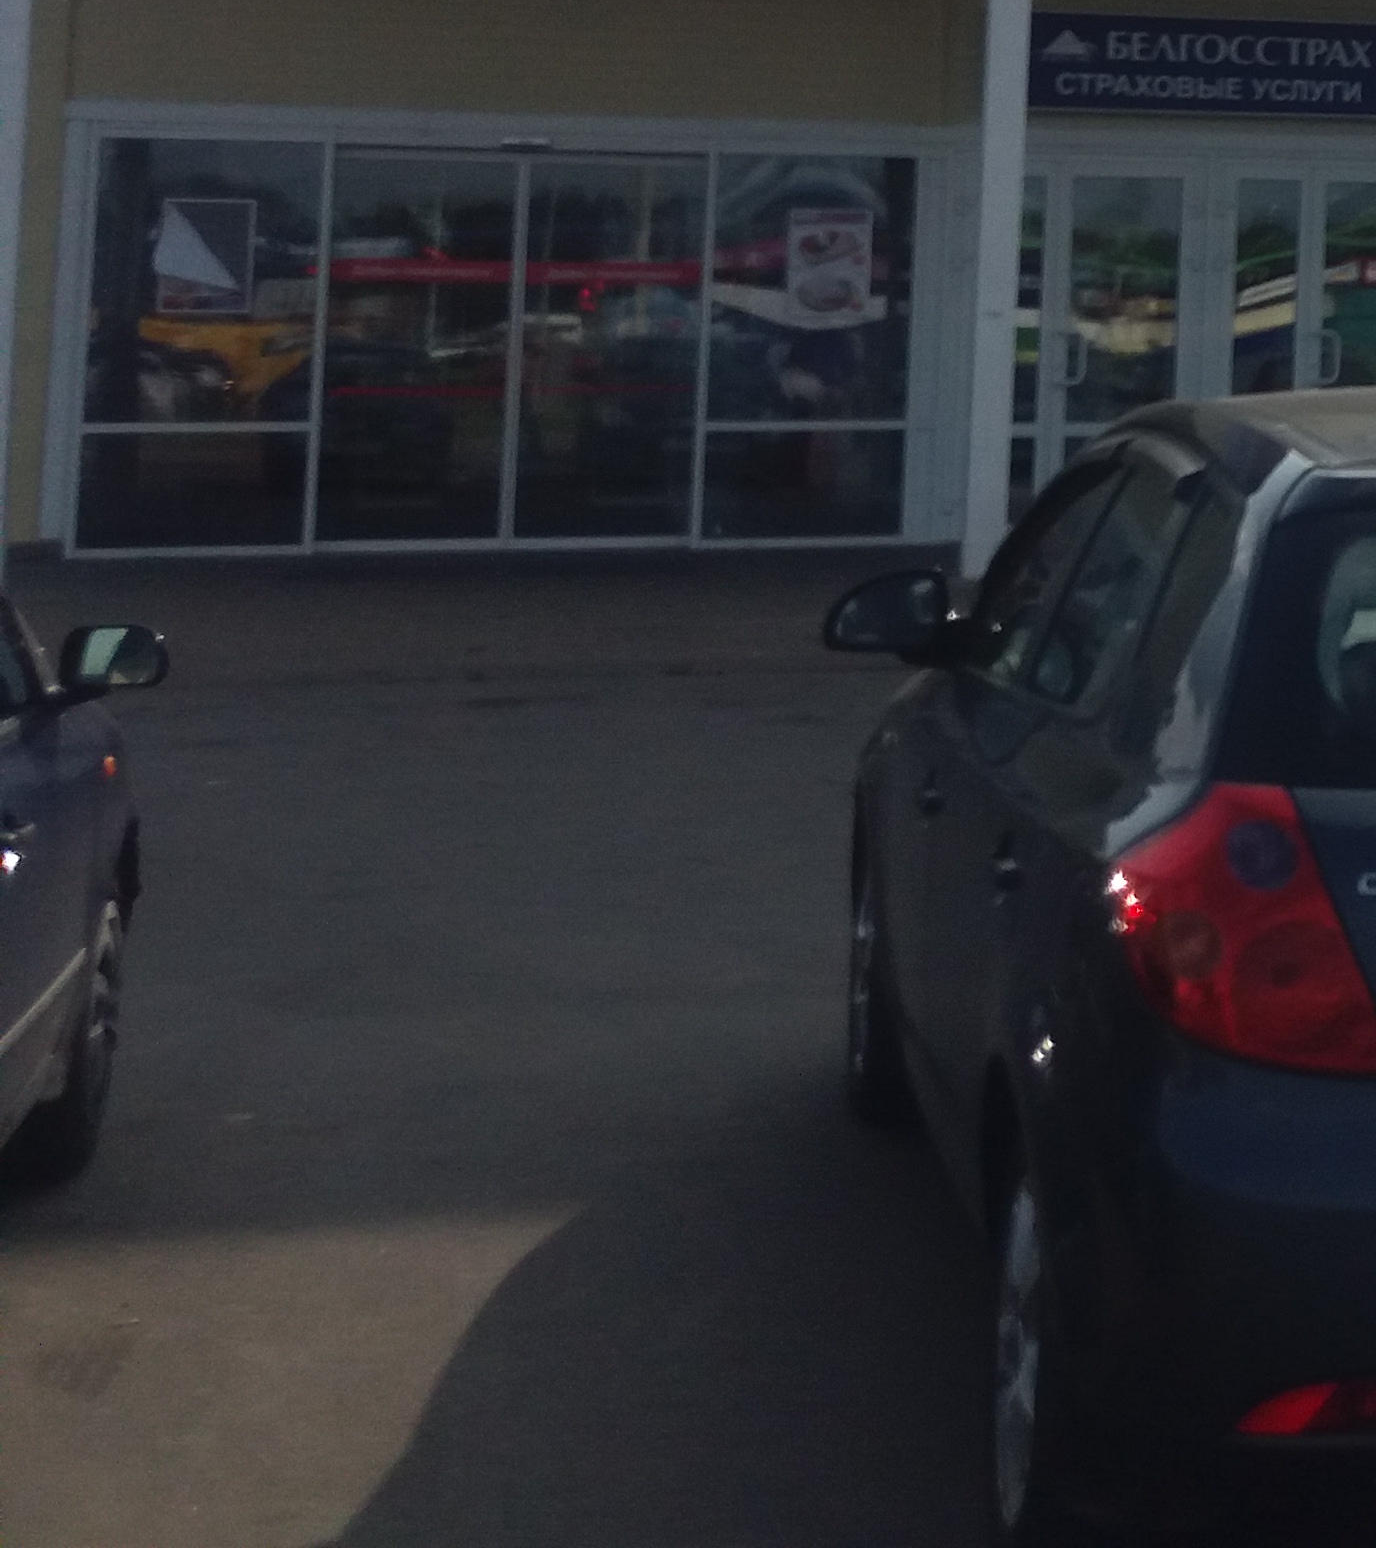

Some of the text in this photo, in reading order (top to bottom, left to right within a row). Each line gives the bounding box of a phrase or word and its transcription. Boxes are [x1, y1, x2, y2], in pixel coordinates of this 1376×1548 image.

[1105, 29, 1373, 69] БЕЛГОССТРАХ
[1054, 71, 1363, 104] СТРАХОВЫЕ УСЛУГИ
